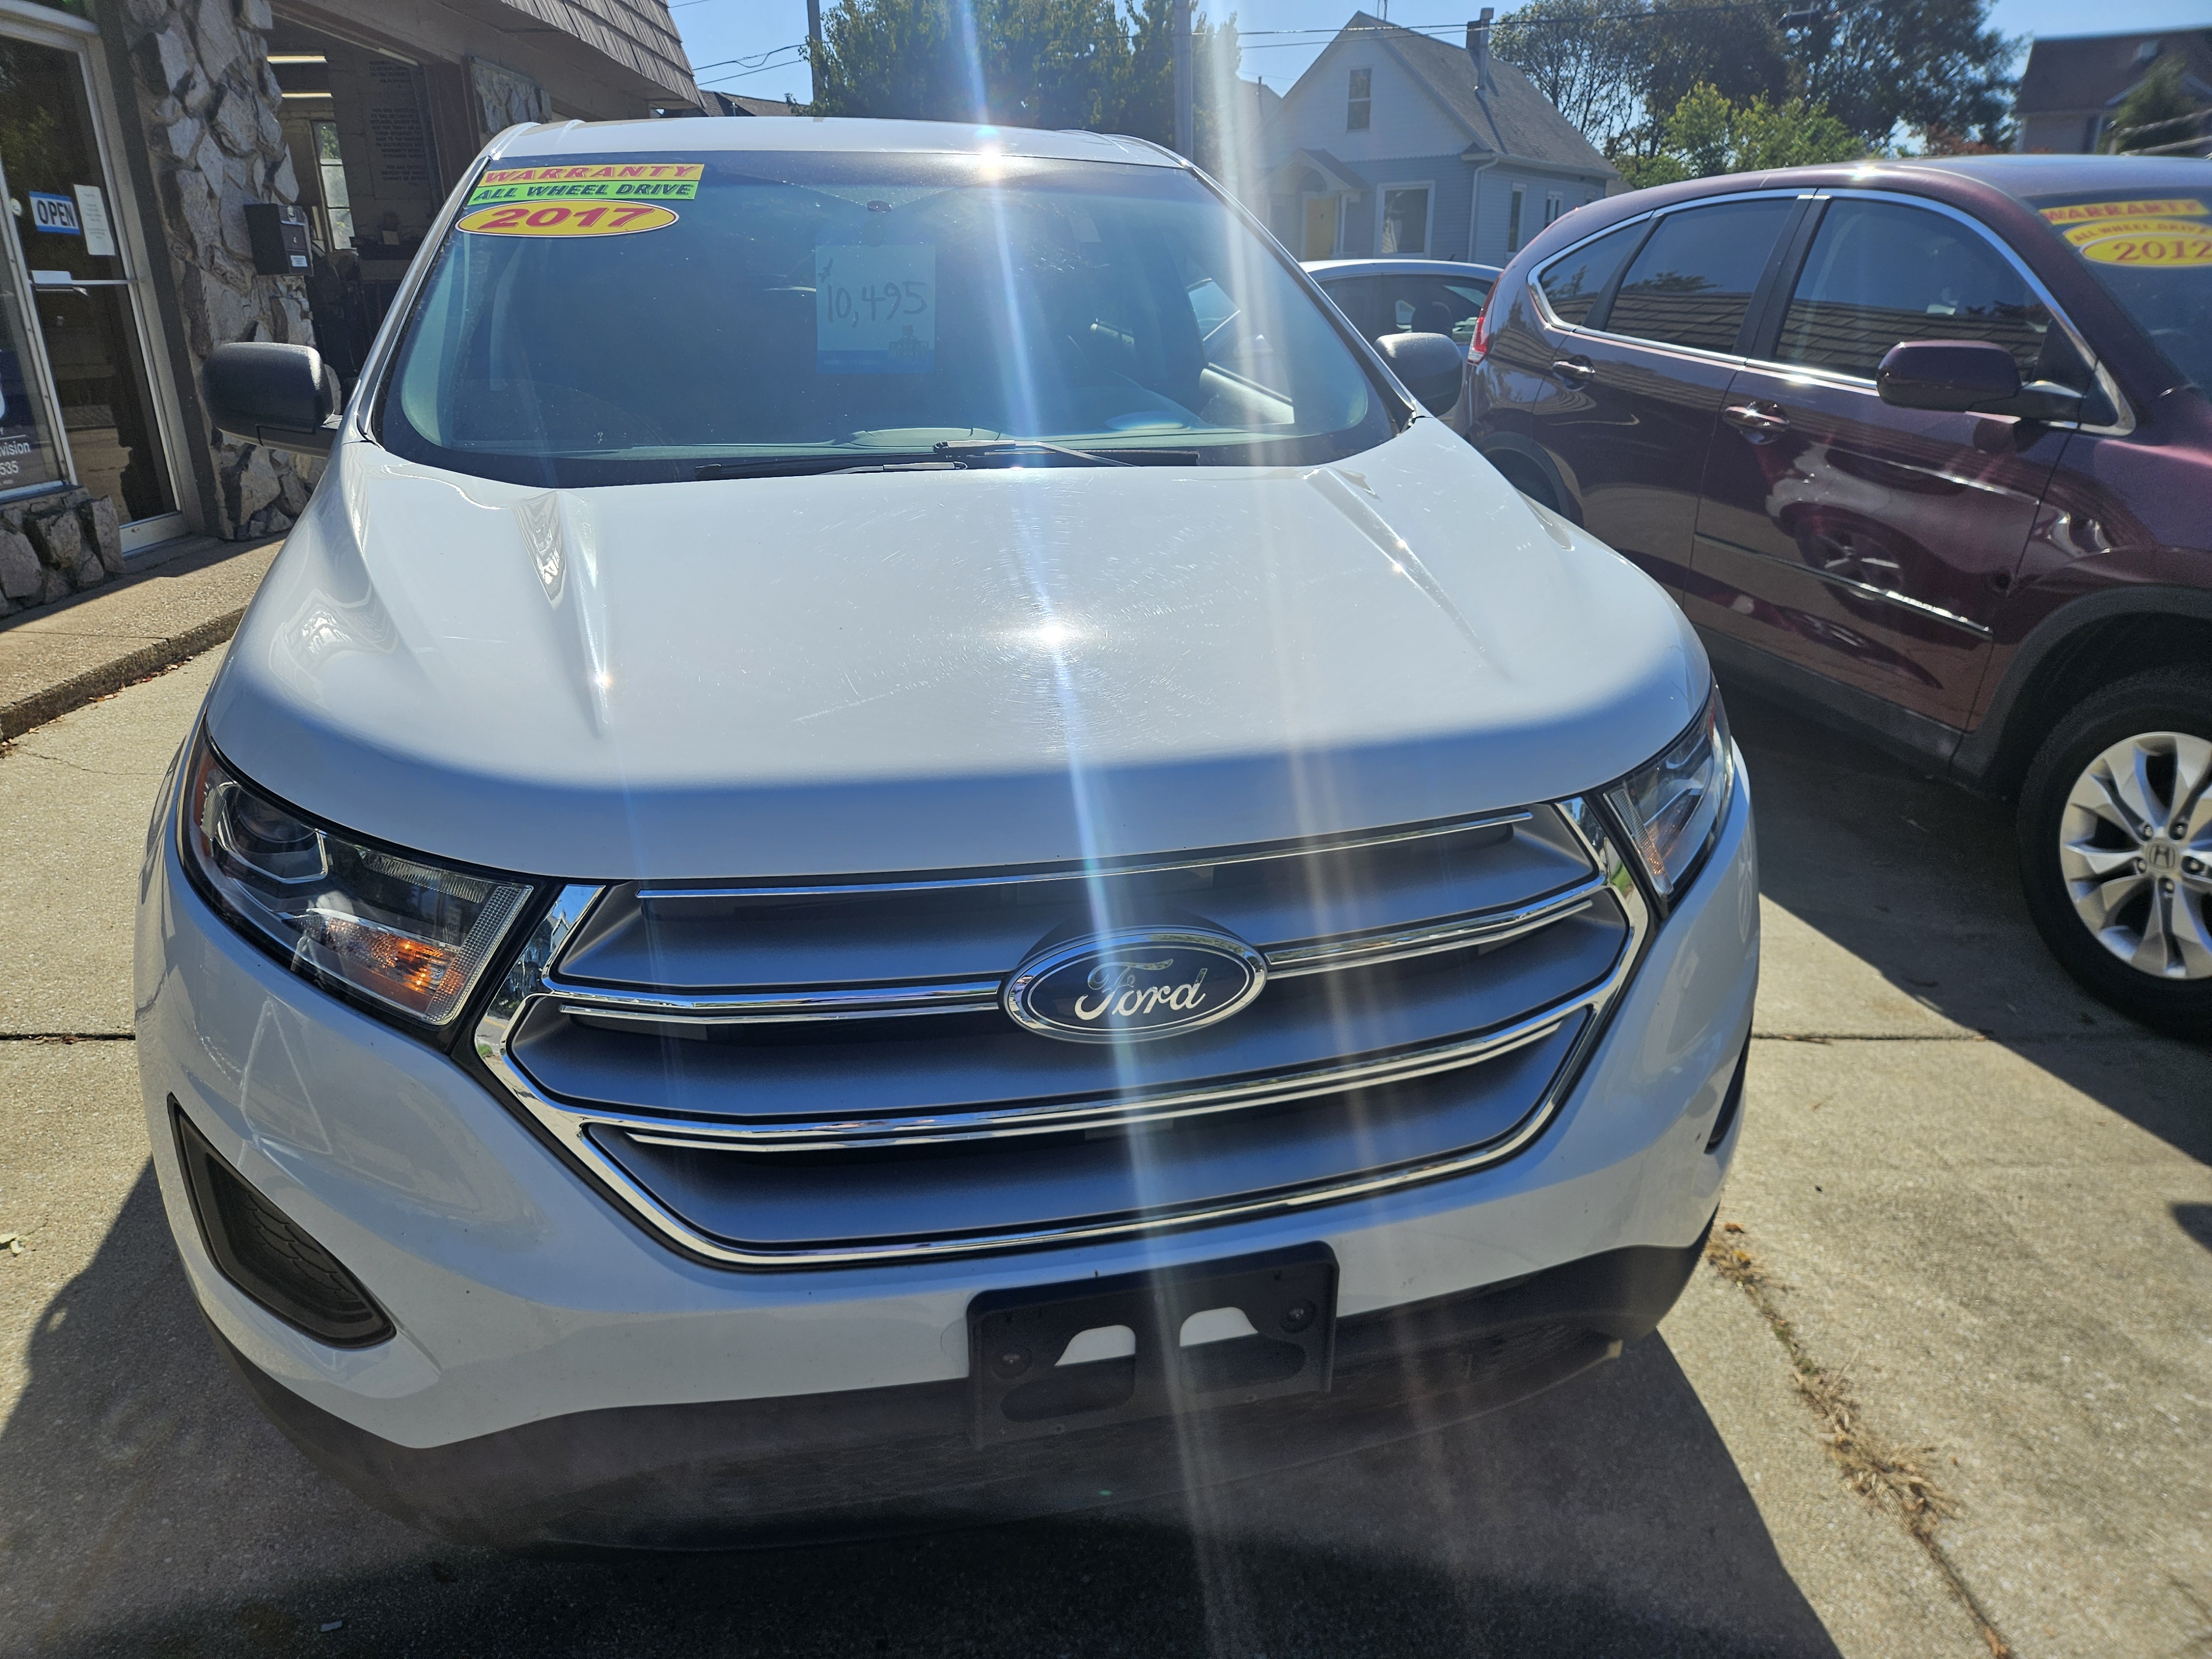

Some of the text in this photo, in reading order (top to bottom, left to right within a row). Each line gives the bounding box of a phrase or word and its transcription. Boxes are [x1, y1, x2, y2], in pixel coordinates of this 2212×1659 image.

[484, 166, 696, 183] WARRANTY
[473, 183, 695, 202] ALL WHEEL DRIVE
[36, 199, 76, 227] OPEN
[476, 207, 656, 230] 2017
[2042, 201, 2198, 221] WARRANTY
[2073, 229, 2095, 242] ALL
[2099, 223, 2149, 234] WHEEL
[2112, 239, 2212, 261] 2012
[0, 441, 30, 457] vision
[1074, 958, 1208, 1021] Ford
